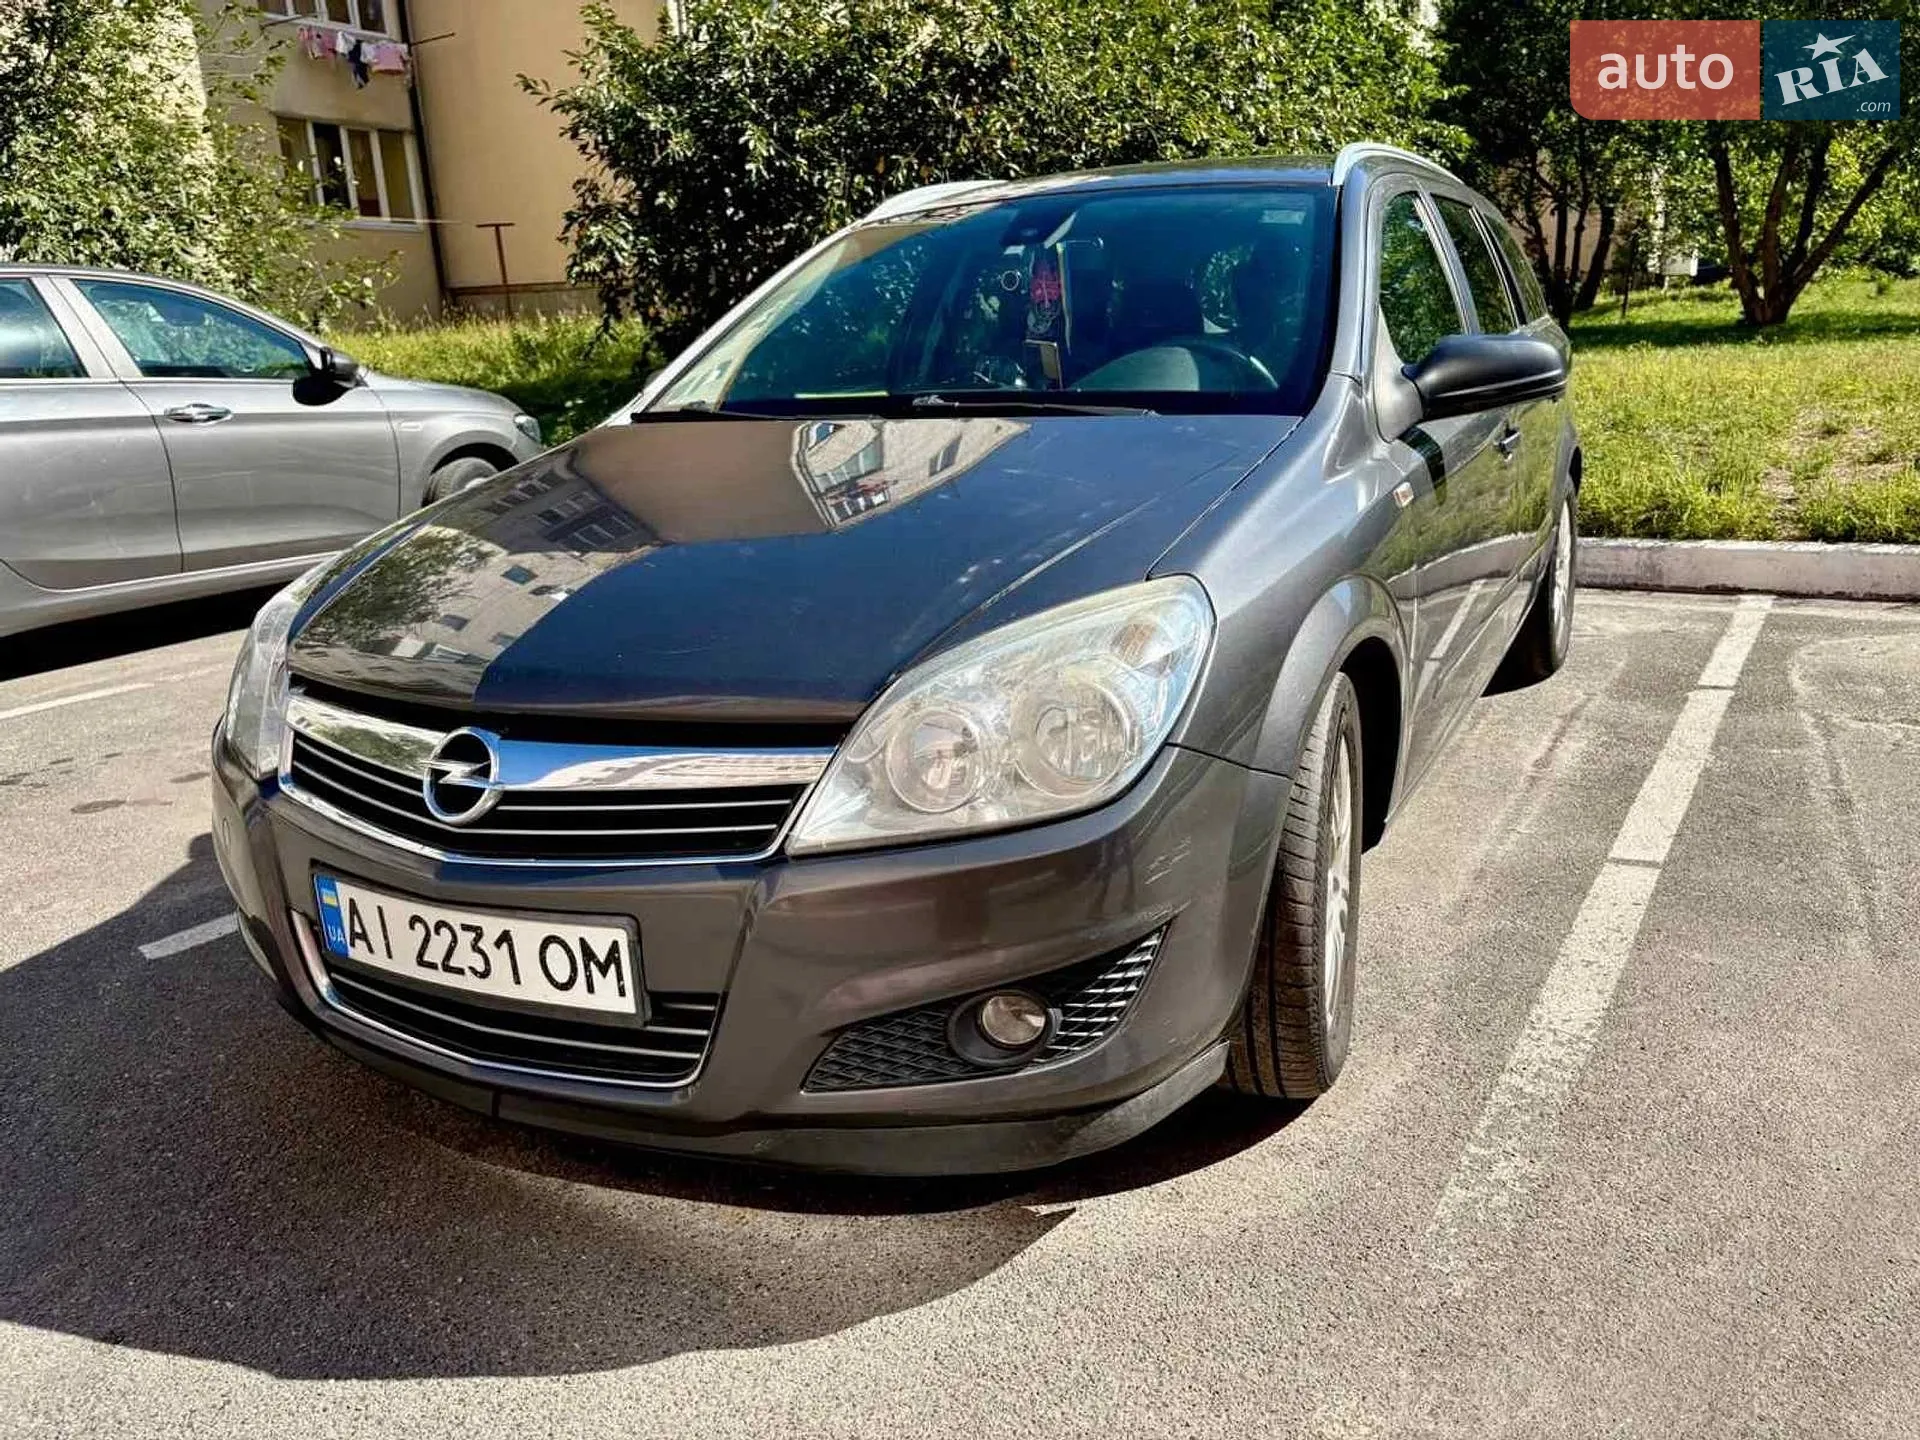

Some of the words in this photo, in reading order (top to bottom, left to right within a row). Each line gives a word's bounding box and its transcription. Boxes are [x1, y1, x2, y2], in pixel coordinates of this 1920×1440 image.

[328, 926, 347, 944] UA
[349, 898, 392, 959] AI
[409, 914, 521, 985] 2231
[539, 934, 626, 997] OM
